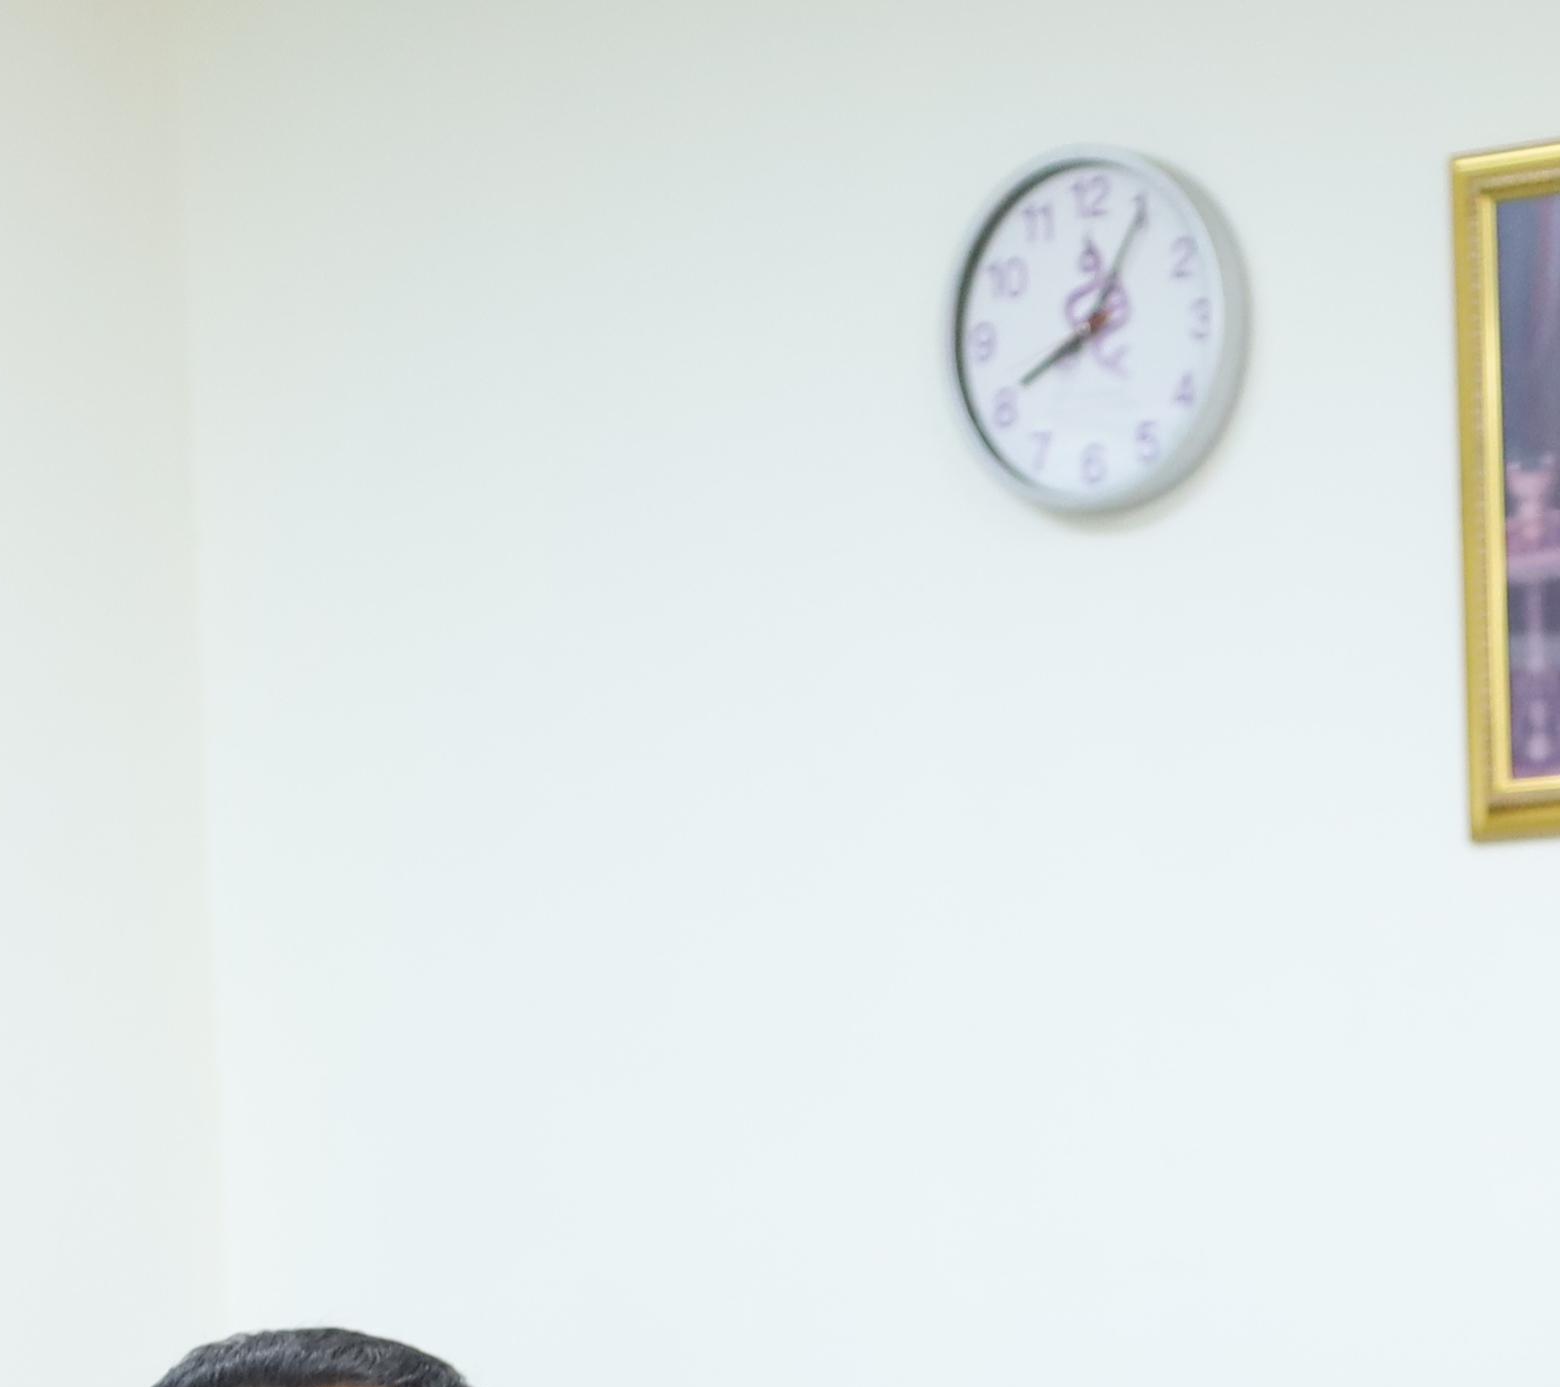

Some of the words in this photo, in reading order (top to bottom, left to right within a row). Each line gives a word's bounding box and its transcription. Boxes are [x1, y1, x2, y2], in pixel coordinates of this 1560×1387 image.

[1072, 175, 1110, 218] 12
[1023, 204, 1055, 241] 11
[989, 256, 1029, 299] 10
[1172, 236, 1198, 279] 2
[1191, 298, 1211, 340] 3
[971, 321, 997, 363] 9
[995, 386, 1019, 429] 8
[1174, 371, 1196, 406] 4
[1030, 431, 1052, 471] 7
[1135, 421, 1160, 462] 5
[1081, 443, 1107, 485] 6
